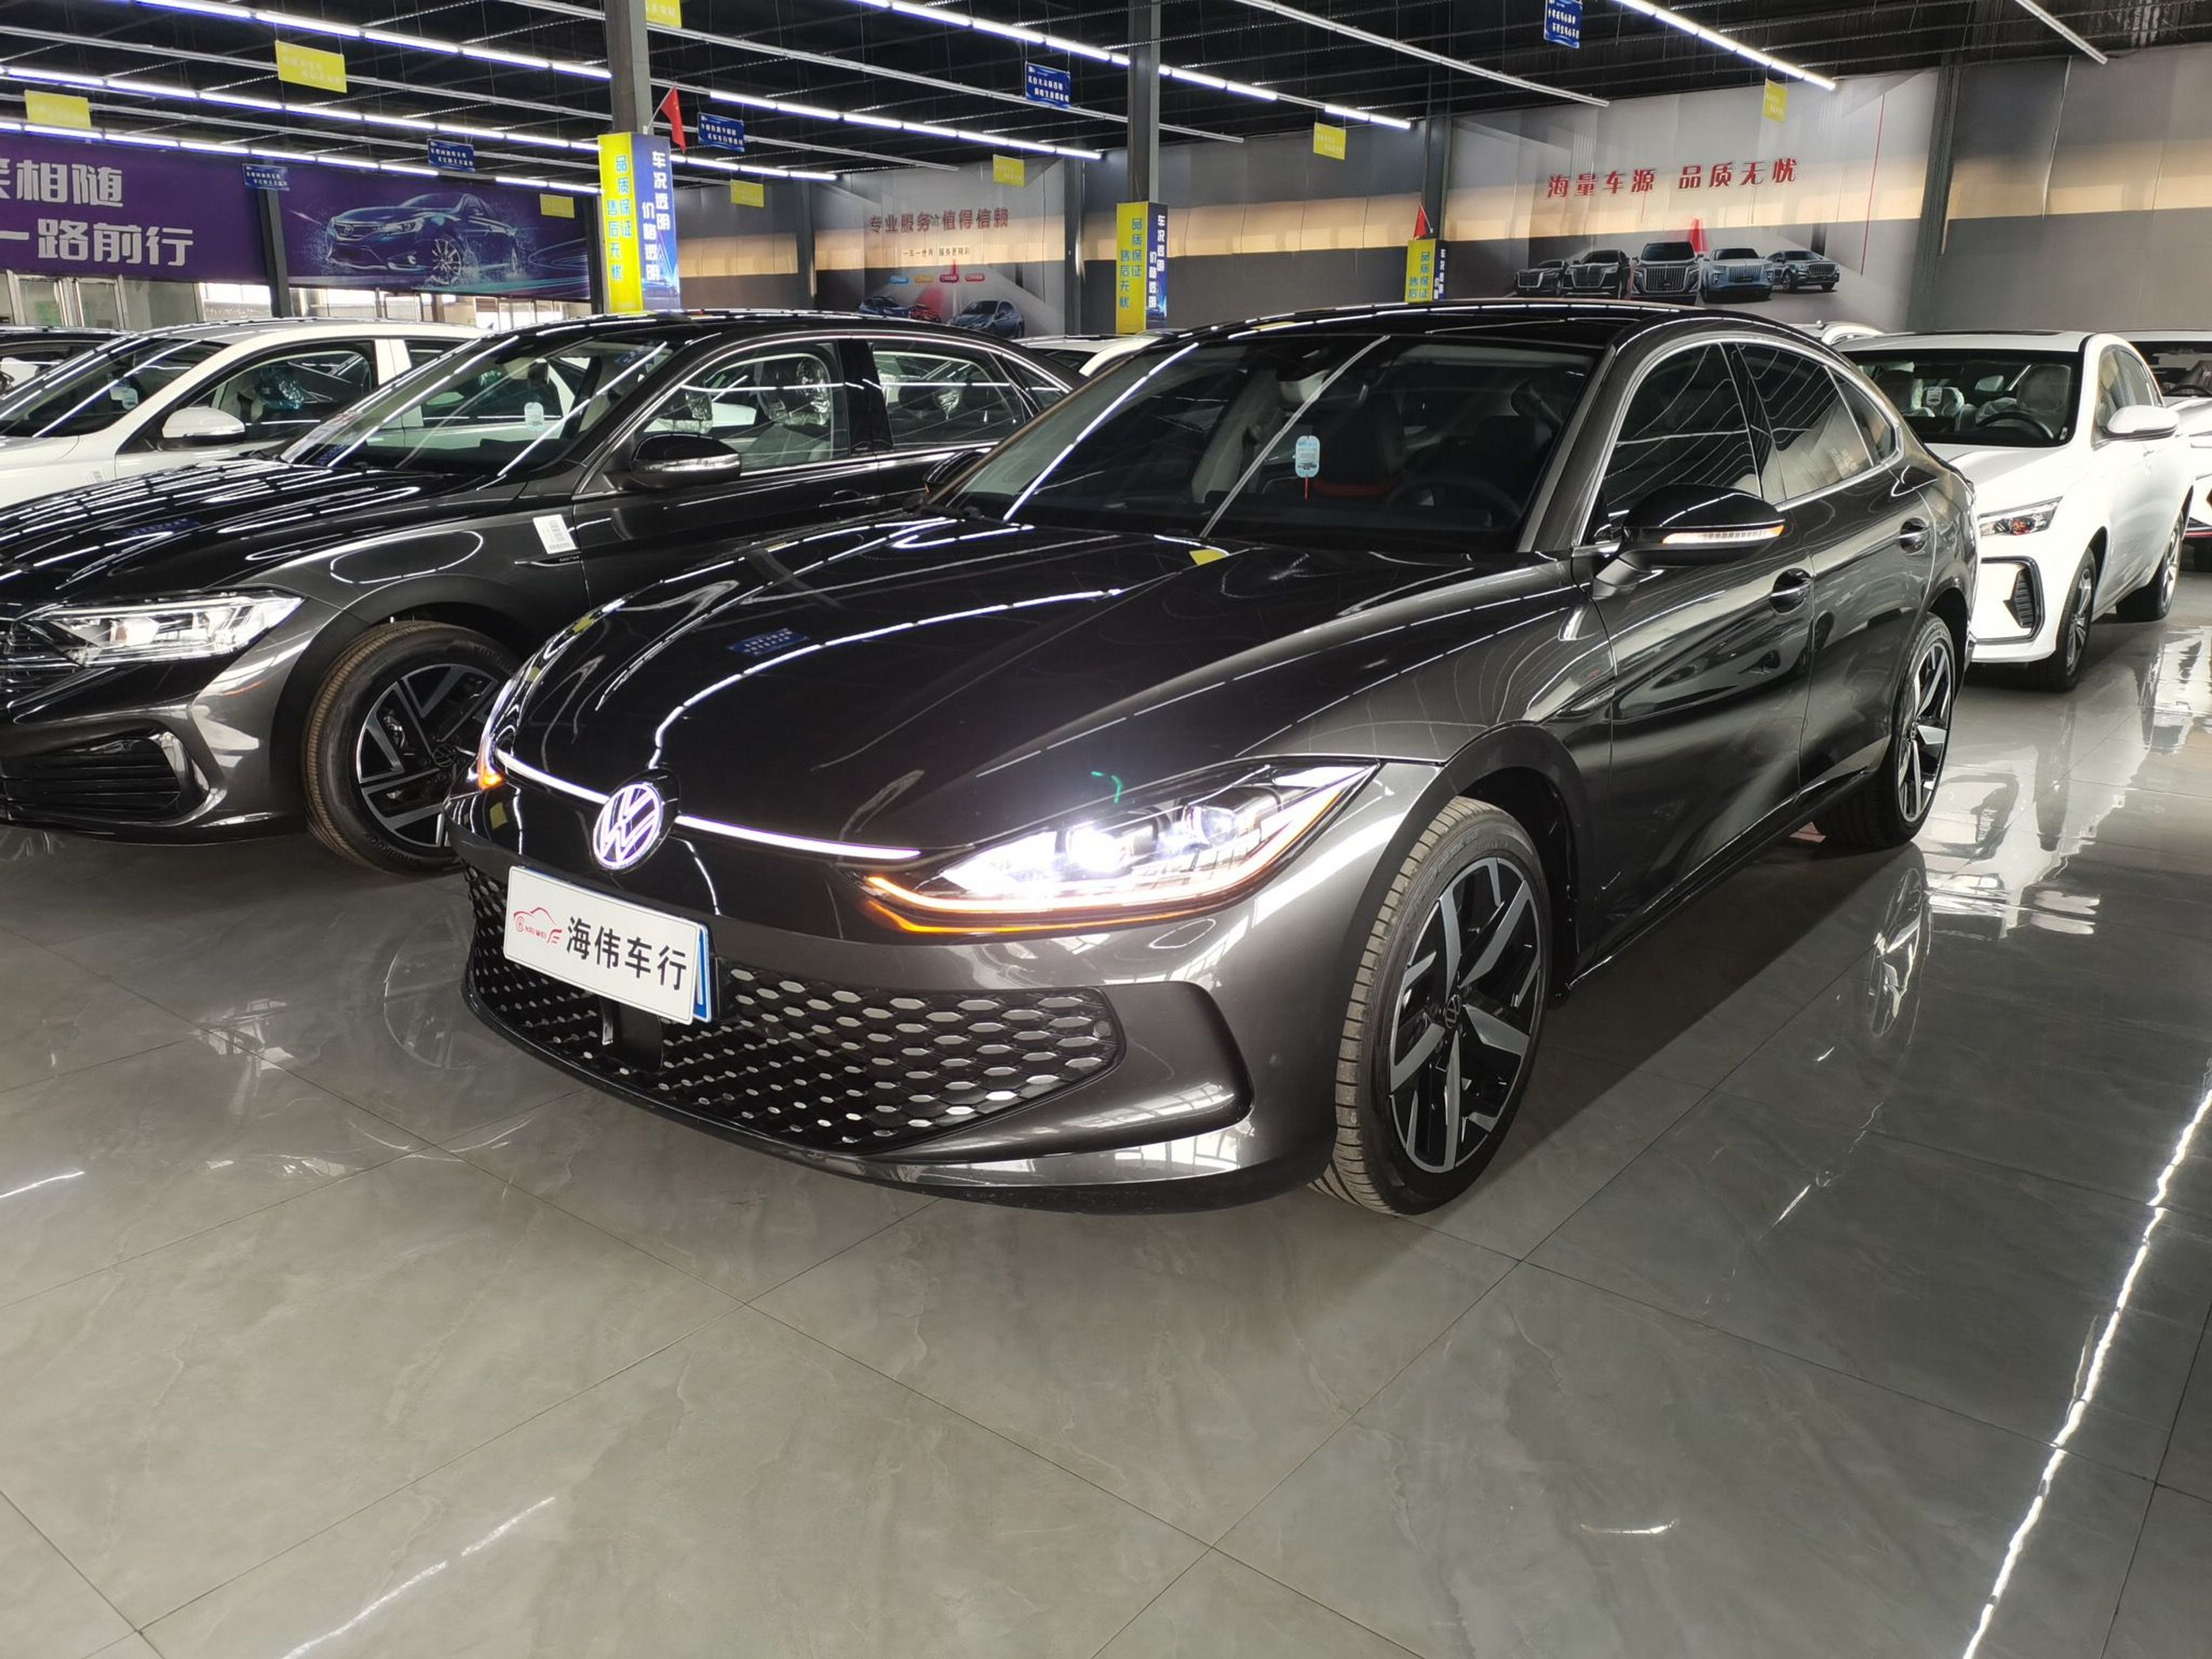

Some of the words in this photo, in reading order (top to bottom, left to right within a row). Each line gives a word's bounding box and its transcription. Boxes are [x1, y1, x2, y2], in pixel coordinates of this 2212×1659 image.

[0, 158, 123, 207] 相随
[616, 156, 632, 238] 品质保证
[652, 150, 671, 230] 车况透明
[1547, 168, 1657, 198] 海量车源
[1678, 158, 1798, 190] 品质无忧
[0, 218, 194, 266] 一路前行
[607, 199, 622, 281] 售后无忧
[642, 202, 660, 281] 价格透明
[869, 211, 931, 233] 专业服务
[943, 207, 1010, 230] 值得信赖
[1132, 218, 1142, 277] 品质保证
[567, 916, 687, 991] 海伟车行
